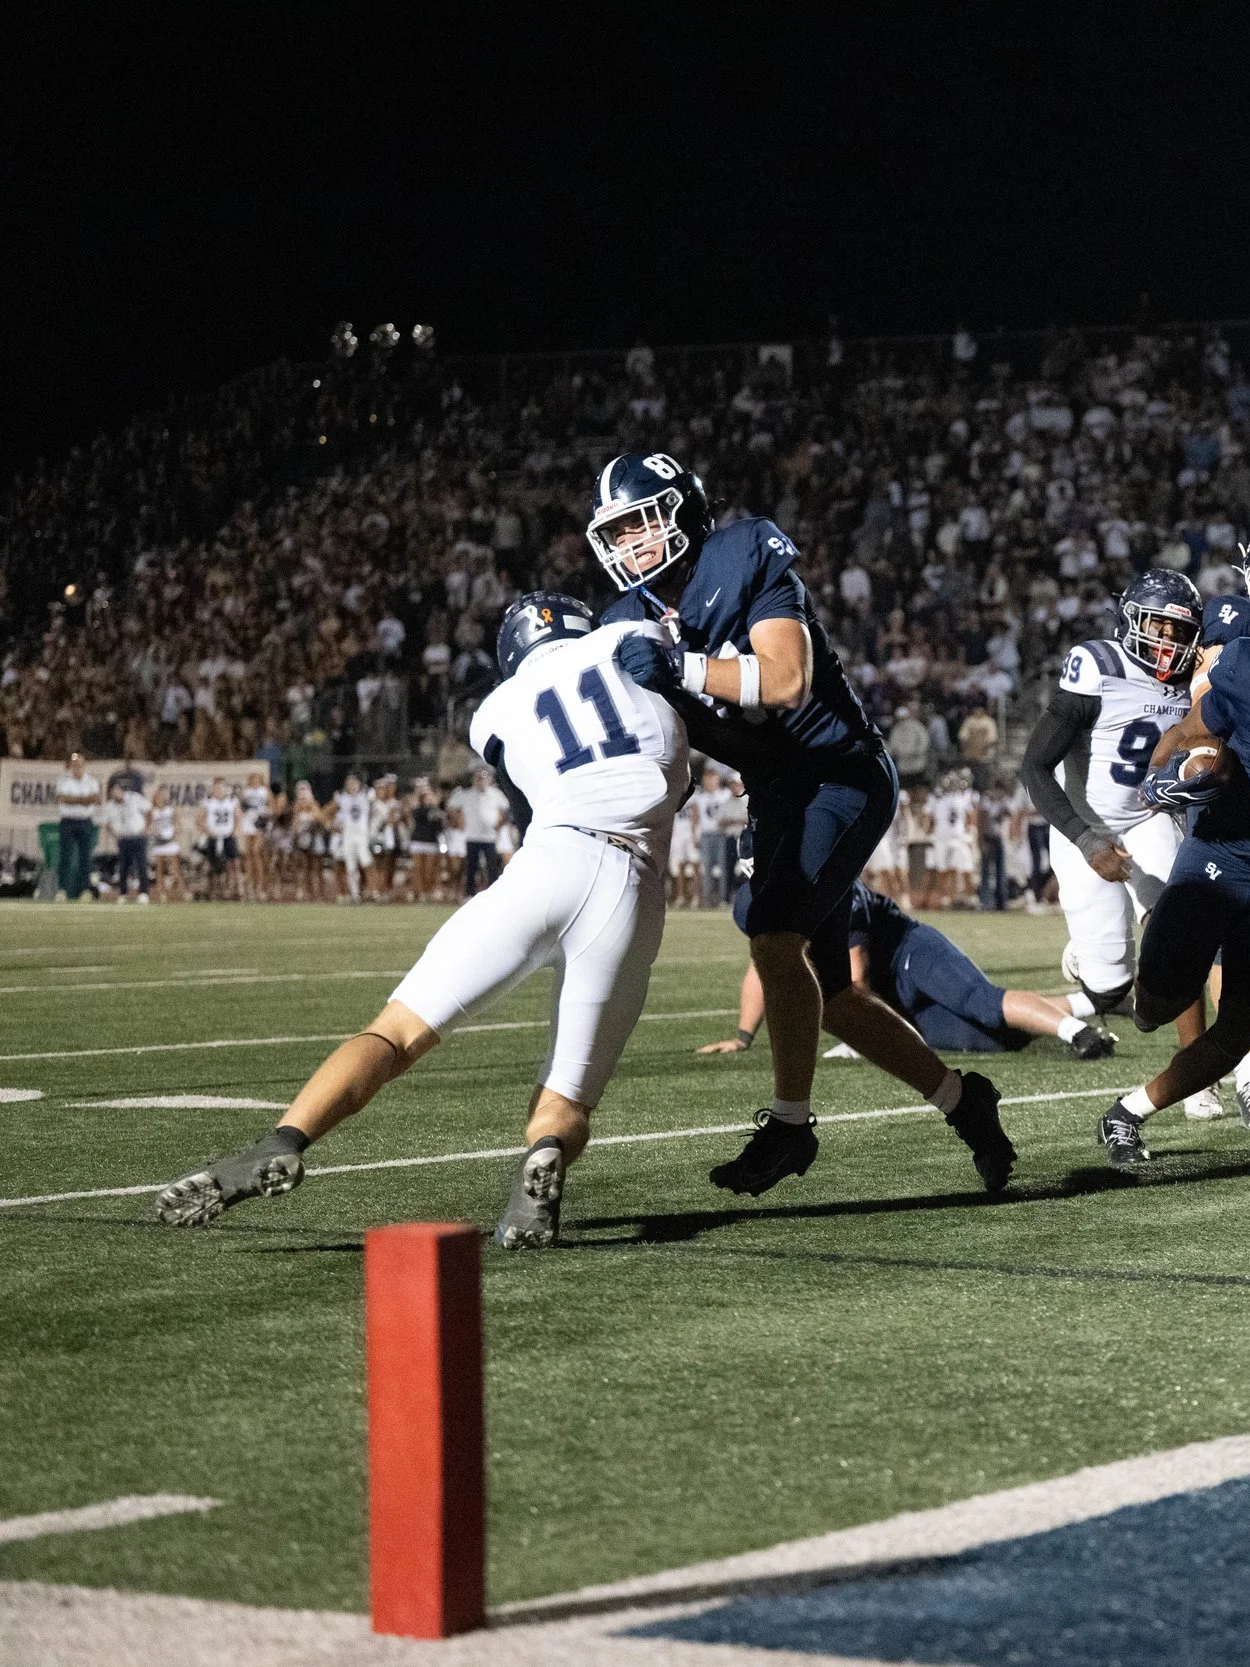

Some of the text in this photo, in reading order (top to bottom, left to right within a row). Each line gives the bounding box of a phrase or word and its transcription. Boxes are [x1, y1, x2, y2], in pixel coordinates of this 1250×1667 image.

[1218, 604, 1239, 625] SV
[534, 664, 642, 776] 11
[1204, 861, 1223, 881] SV
